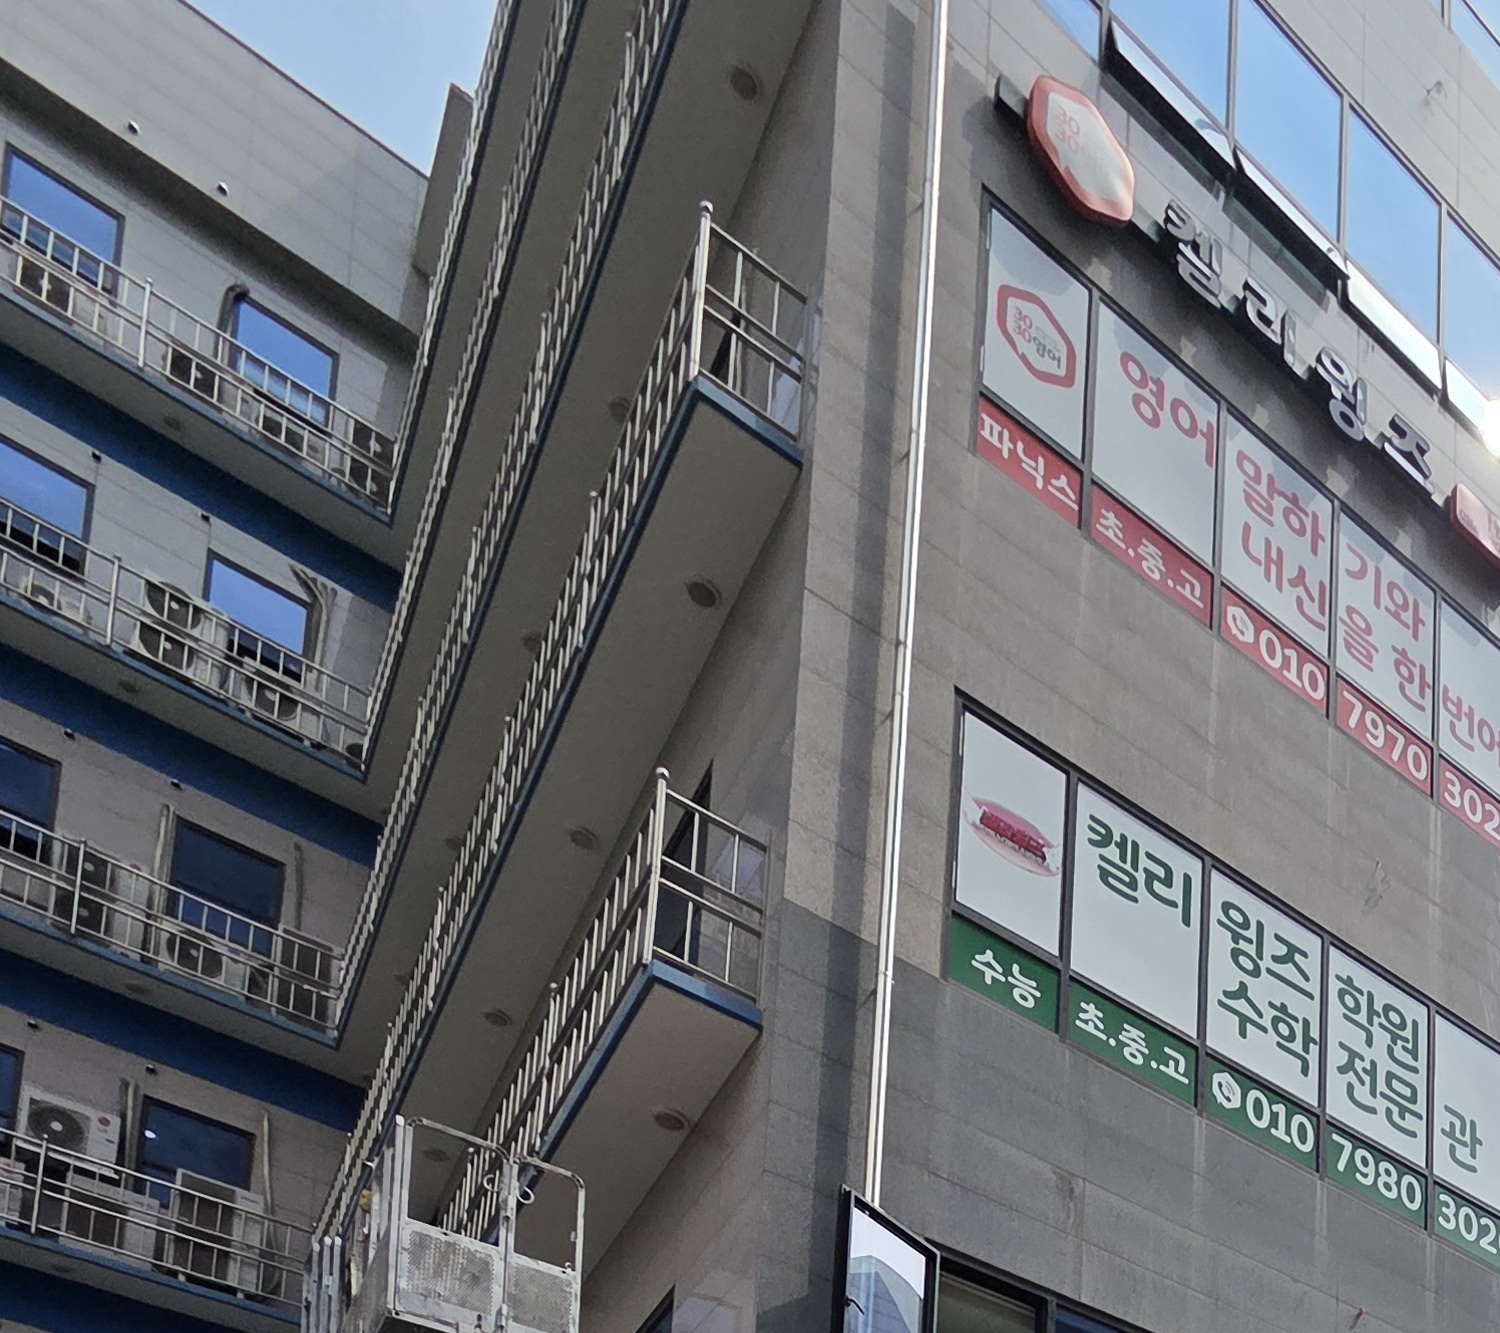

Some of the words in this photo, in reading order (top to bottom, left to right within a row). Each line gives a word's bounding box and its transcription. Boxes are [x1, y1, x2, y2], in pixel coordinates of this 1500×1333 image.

[979, 411, 1079, 512] 파닉스
[1096, 502, 1205, 609] 초.중.고
[1259, 623, 1327, 703] 010
[1343, 688, 1429, 782] 7970
[1119, 350, 1216, 467] 영어
[1235, 448, 1427, 643] 말하기와
[1240, 520, 1377, 674] 내신을
[970, 947, 1042, 1009] 수능
[1075, 999, 1191, 1085] 초.중.고
[1244, 1087, 1315, 1154] 010
[1331, 1133, 1422, 1212] 7980
[1216, 980, 1318, 1078] 수학
[1335, 974, 1421, 1075] 학원
